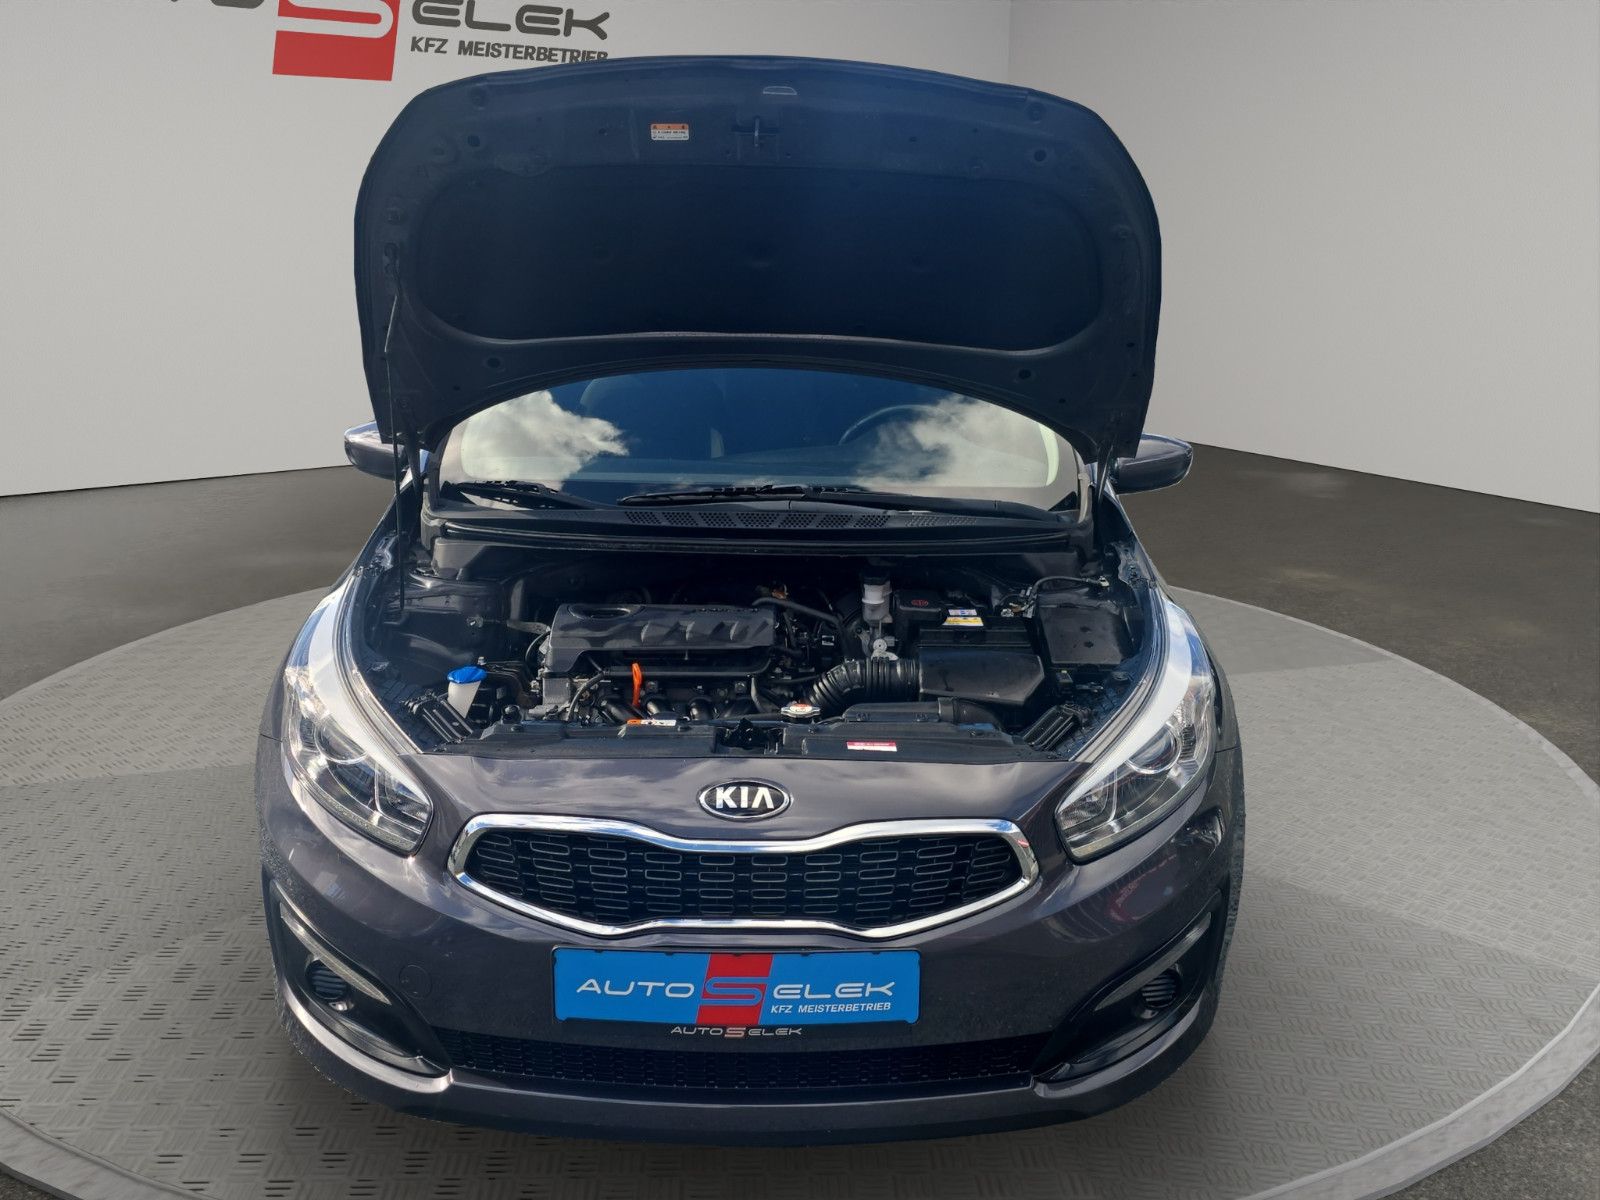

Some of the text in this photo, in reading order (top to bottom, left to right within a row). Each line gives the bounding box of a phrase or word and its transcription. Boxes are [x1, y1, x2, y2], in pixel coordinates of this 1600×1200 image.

[410, 36, 448, 54] KFZ
[715, 786, 775, 809] KIA
[576, 978, 695, 999] AUTO
[770, 1002, 892, 1014] KFZ MEISTERBETRIEB
